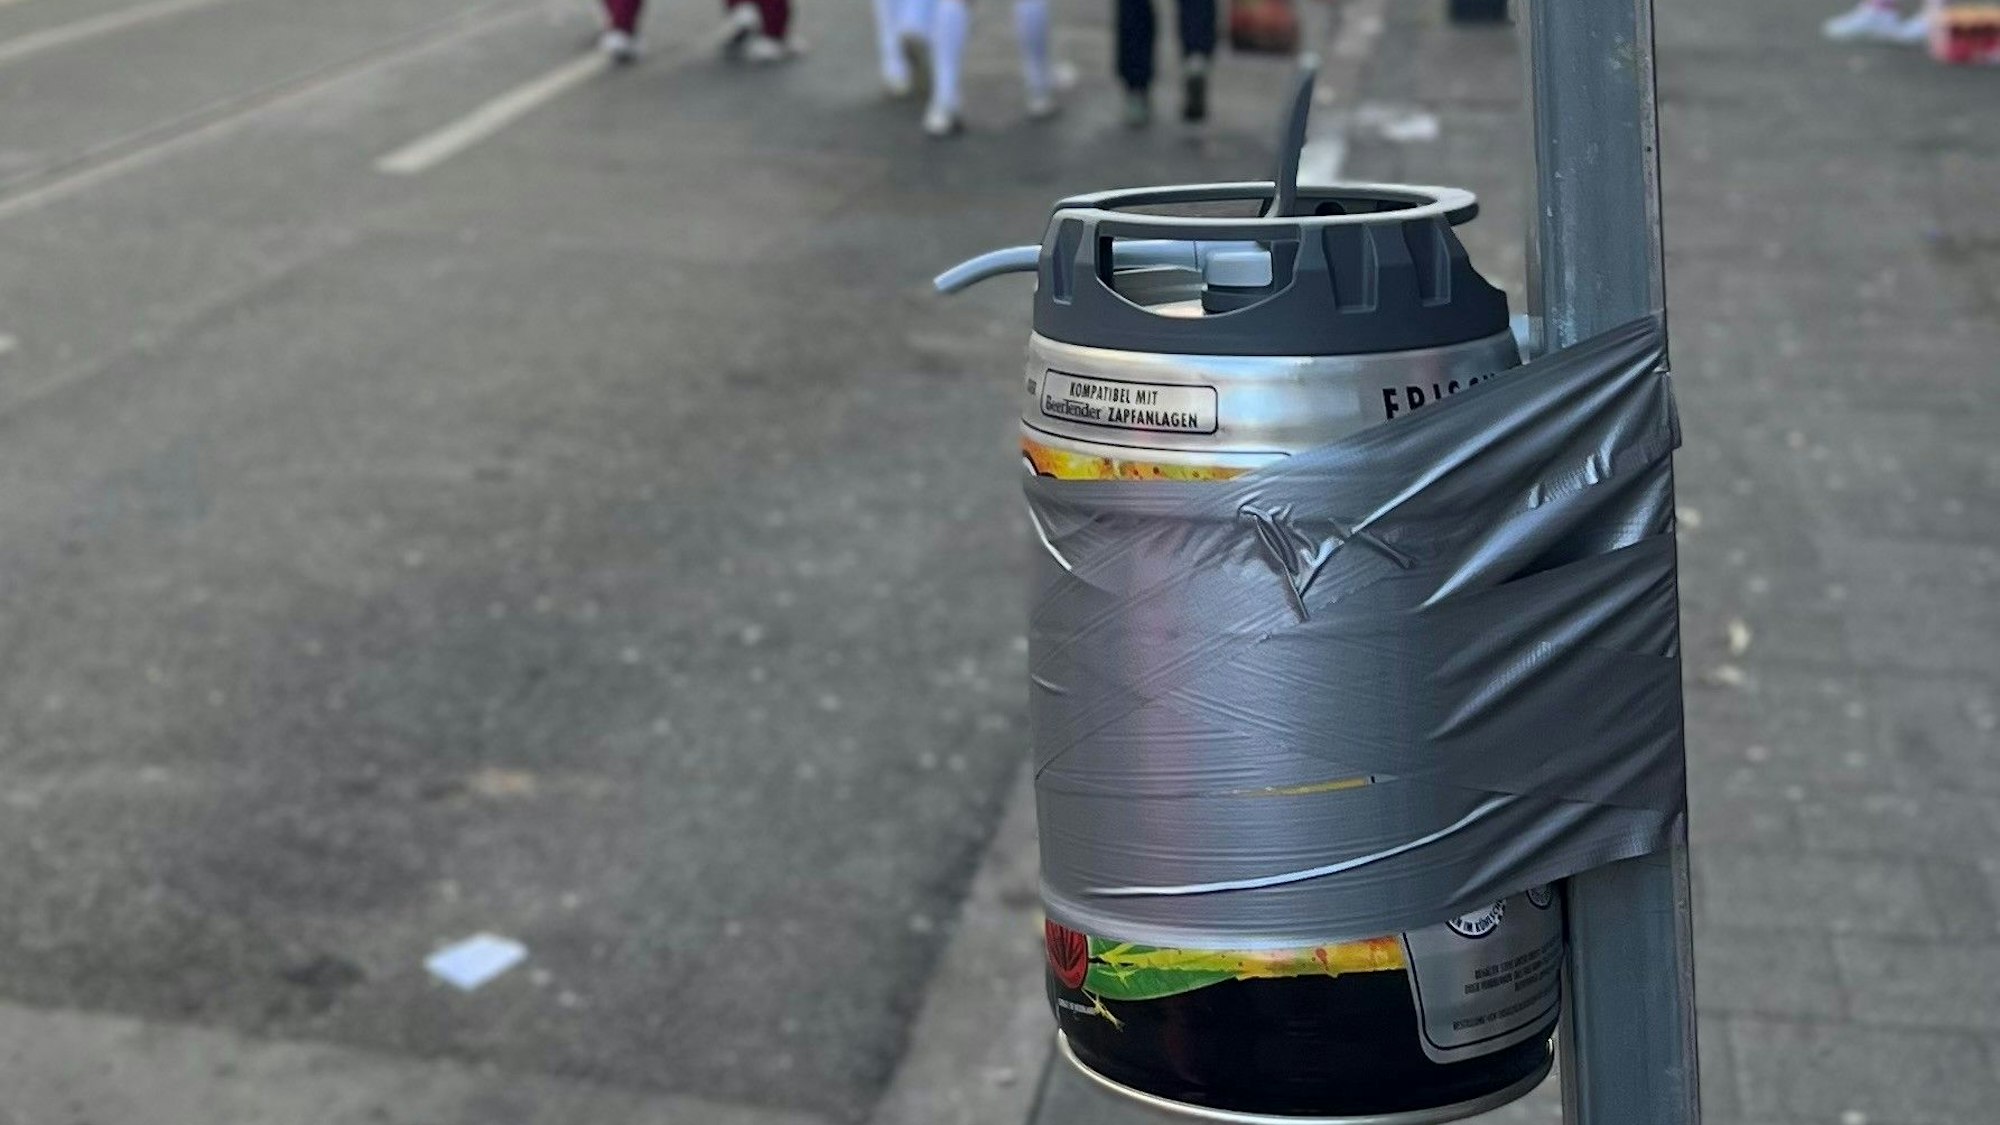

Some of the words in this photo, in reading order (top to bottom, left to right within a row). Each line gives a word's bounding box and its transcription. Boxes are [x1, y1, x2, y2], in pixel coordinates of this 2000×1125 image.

[1070, 382, 1130, 403] KOMPATIBEL
[1136, 389, 1158, 405] MIT
[1046, 394, 1101, 419] BeerTender
[1108, 406, 1198, 428] ZAPFANLAGEN
